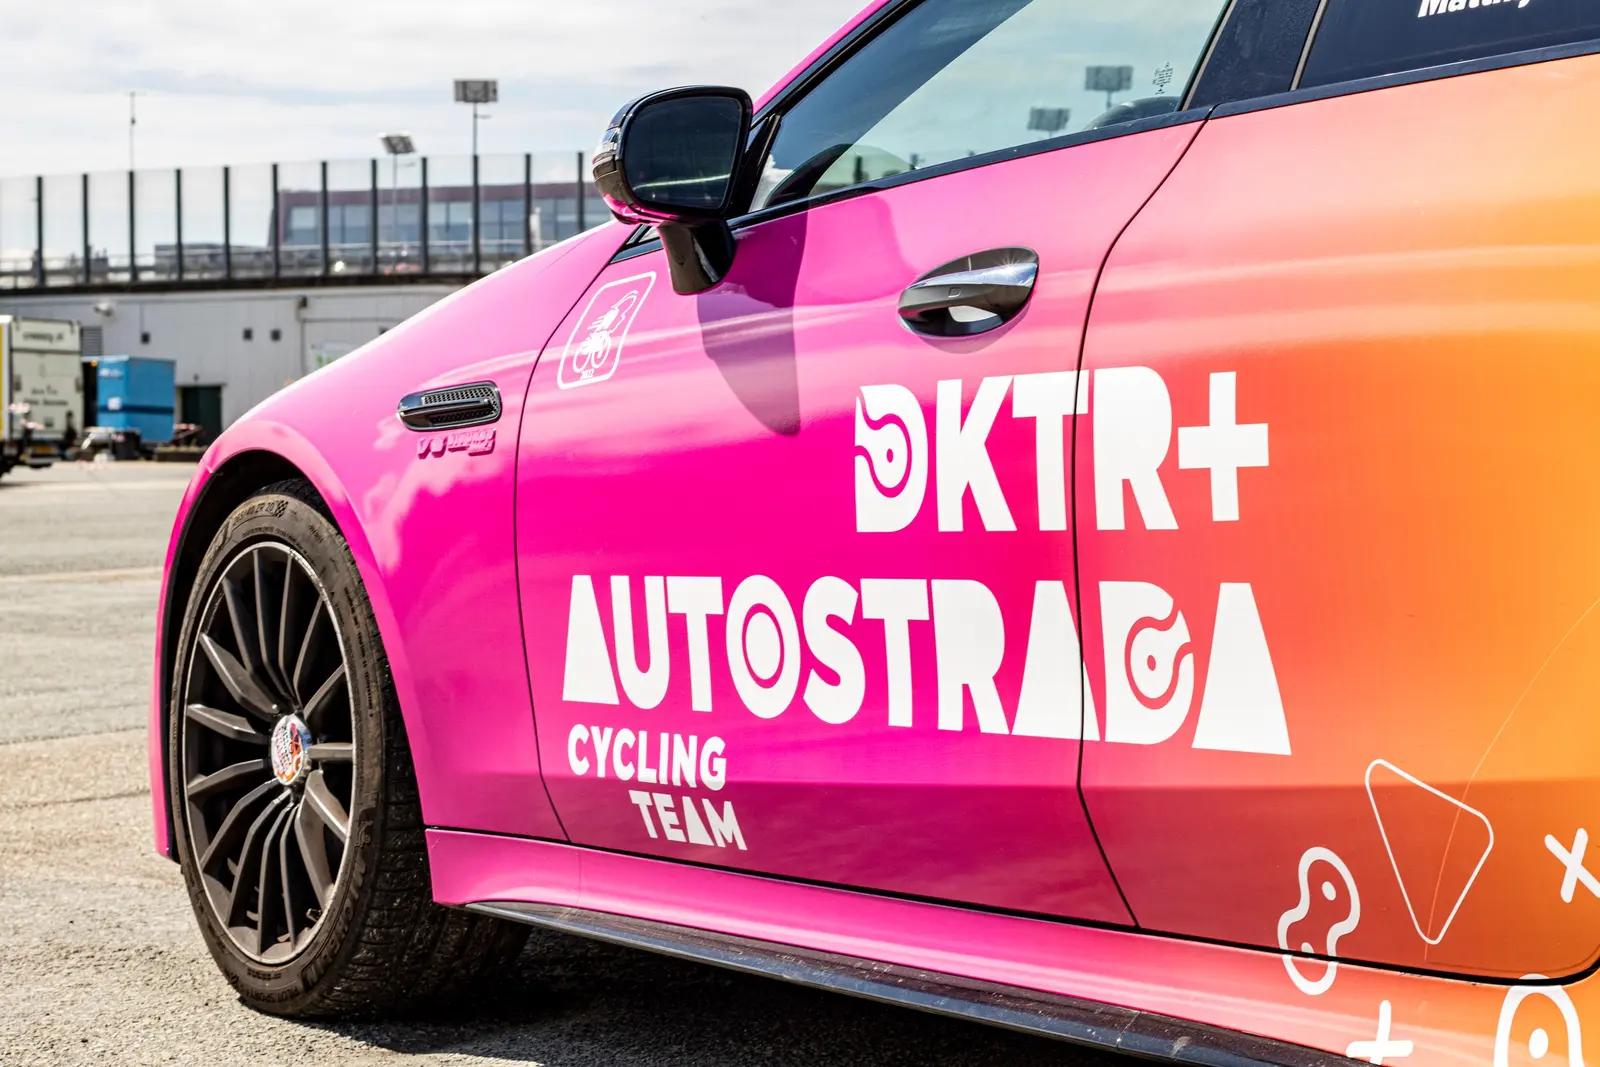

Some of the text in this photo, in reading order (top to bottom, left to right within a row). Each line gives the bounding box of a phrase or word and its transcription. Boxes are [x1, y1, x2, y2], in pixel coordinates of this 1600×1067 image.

[854, 365, 1270, 533] DKTR+
[562, 574, 1292, 756] AUTOSTRADA
[567, 723, 727, 791] CYCLING
[628, 789, 748, 851] TEAM
